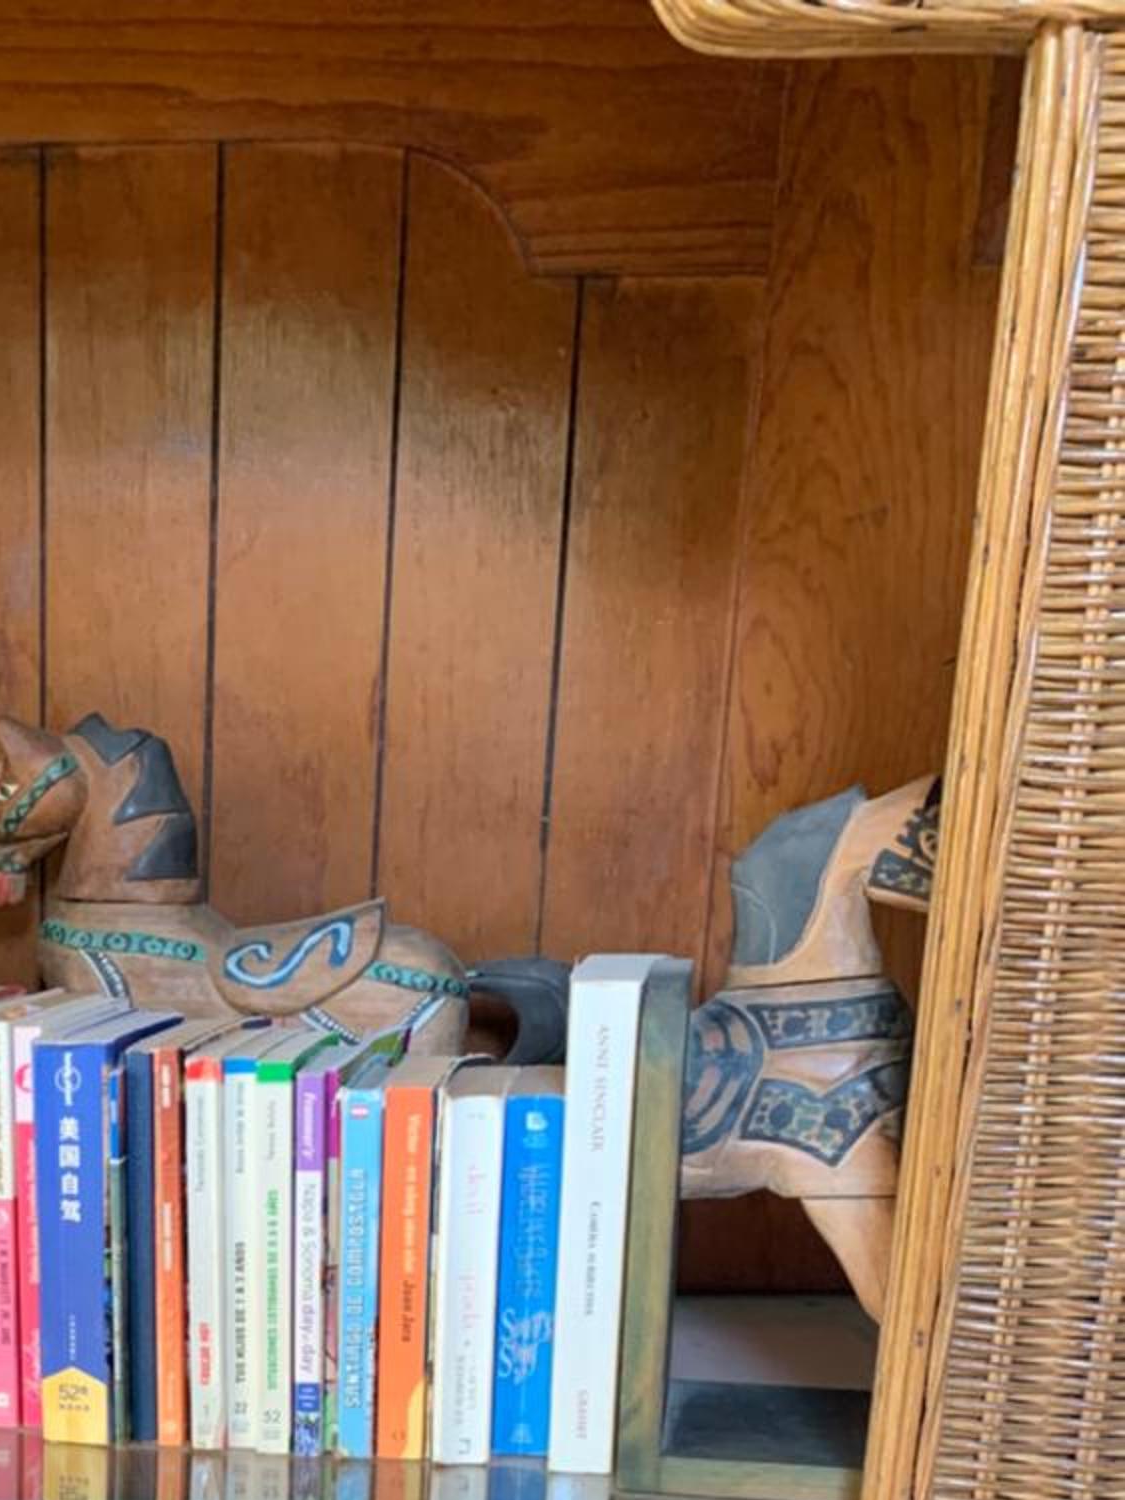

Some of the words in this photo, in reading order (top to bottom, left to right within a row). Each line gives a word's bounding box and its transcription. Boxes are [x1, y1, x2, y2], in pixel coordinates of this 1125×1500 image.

[596, 1024, 611, 1070] ANNE
[589, 1077, 609, 1153] SINCLAIR
[301, 1183, 317, 1222] Napa
[302, 1240, 317, 1301] Sonoma
[299, 1304, 318, 1336] day
[345, 1296, 365, 1314] DE
[299, 1344, 317, 1373] day
